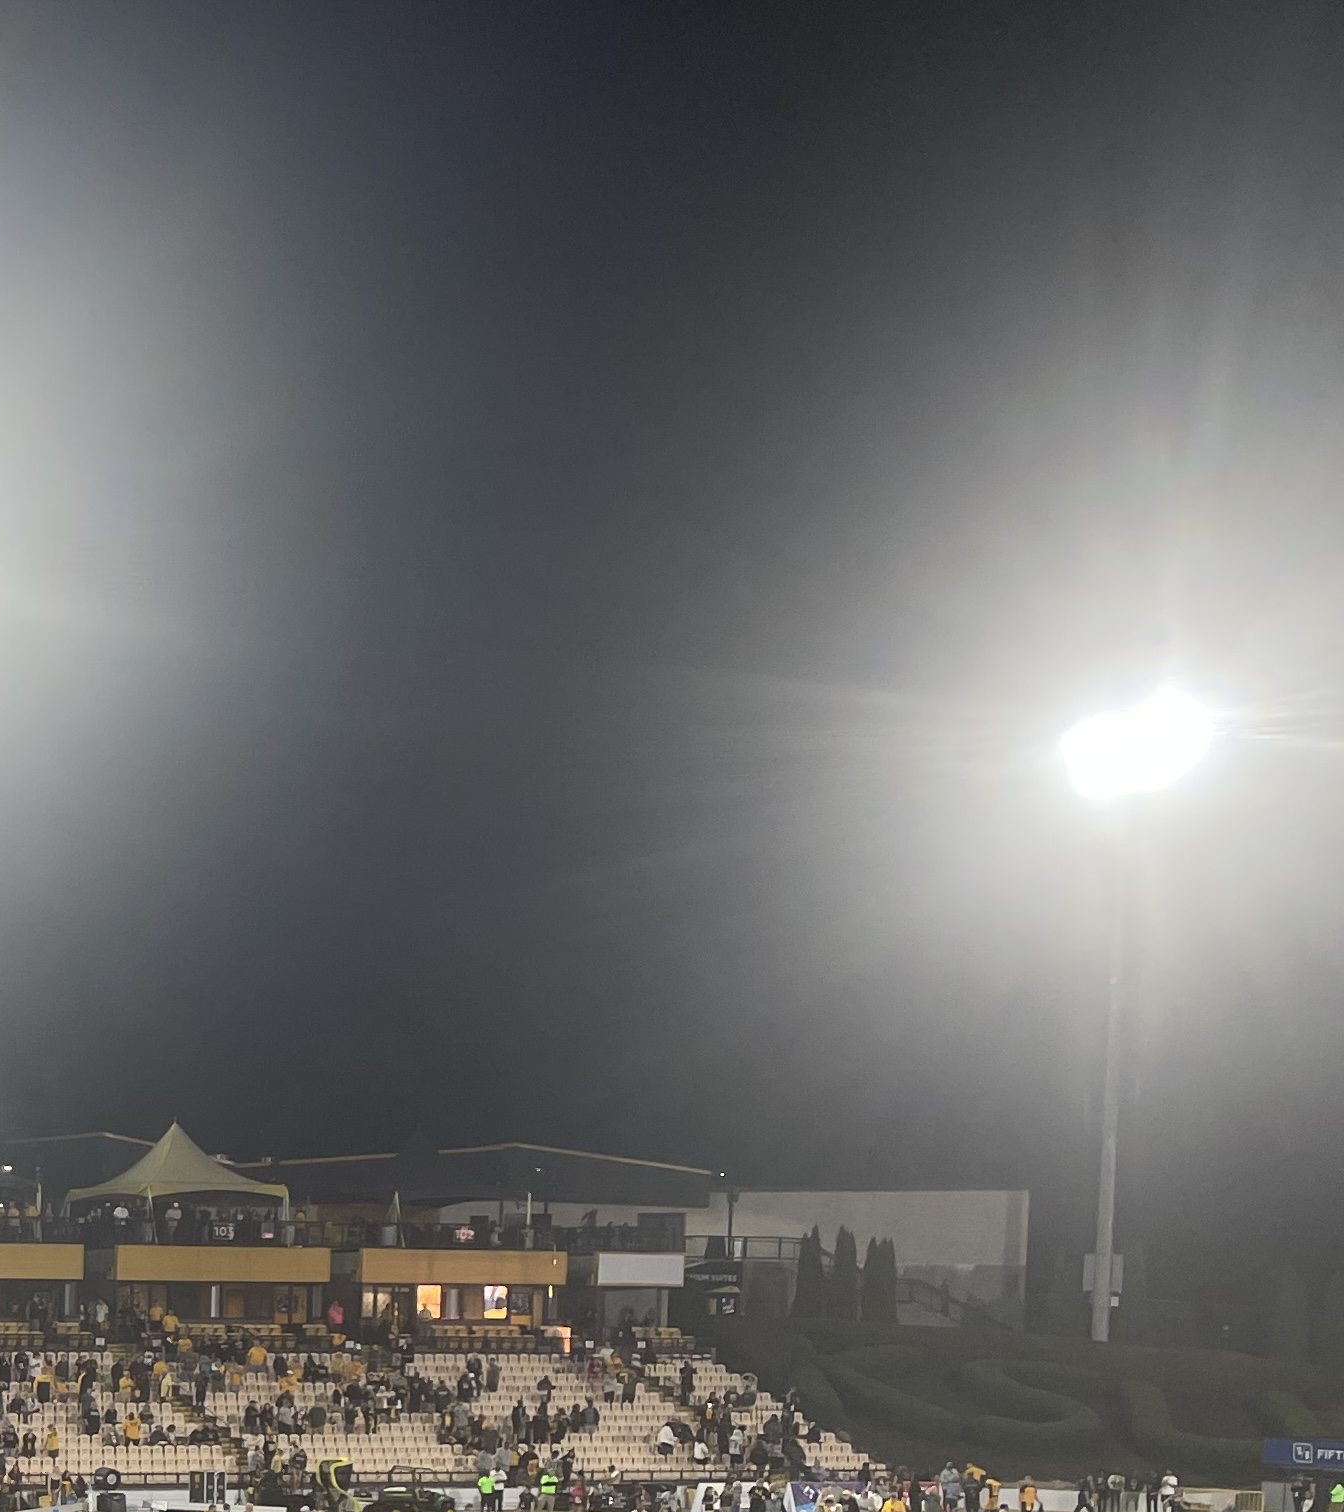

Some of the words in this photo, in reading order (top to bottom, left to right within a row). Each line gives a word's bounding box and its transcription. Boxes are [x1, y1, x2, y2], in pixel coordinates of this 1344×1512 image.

[214, 1224, 235, 1238] 103
[455, 1228, 475, 1240] 102
[1317, 1449, 1344, 1460] FIFT
